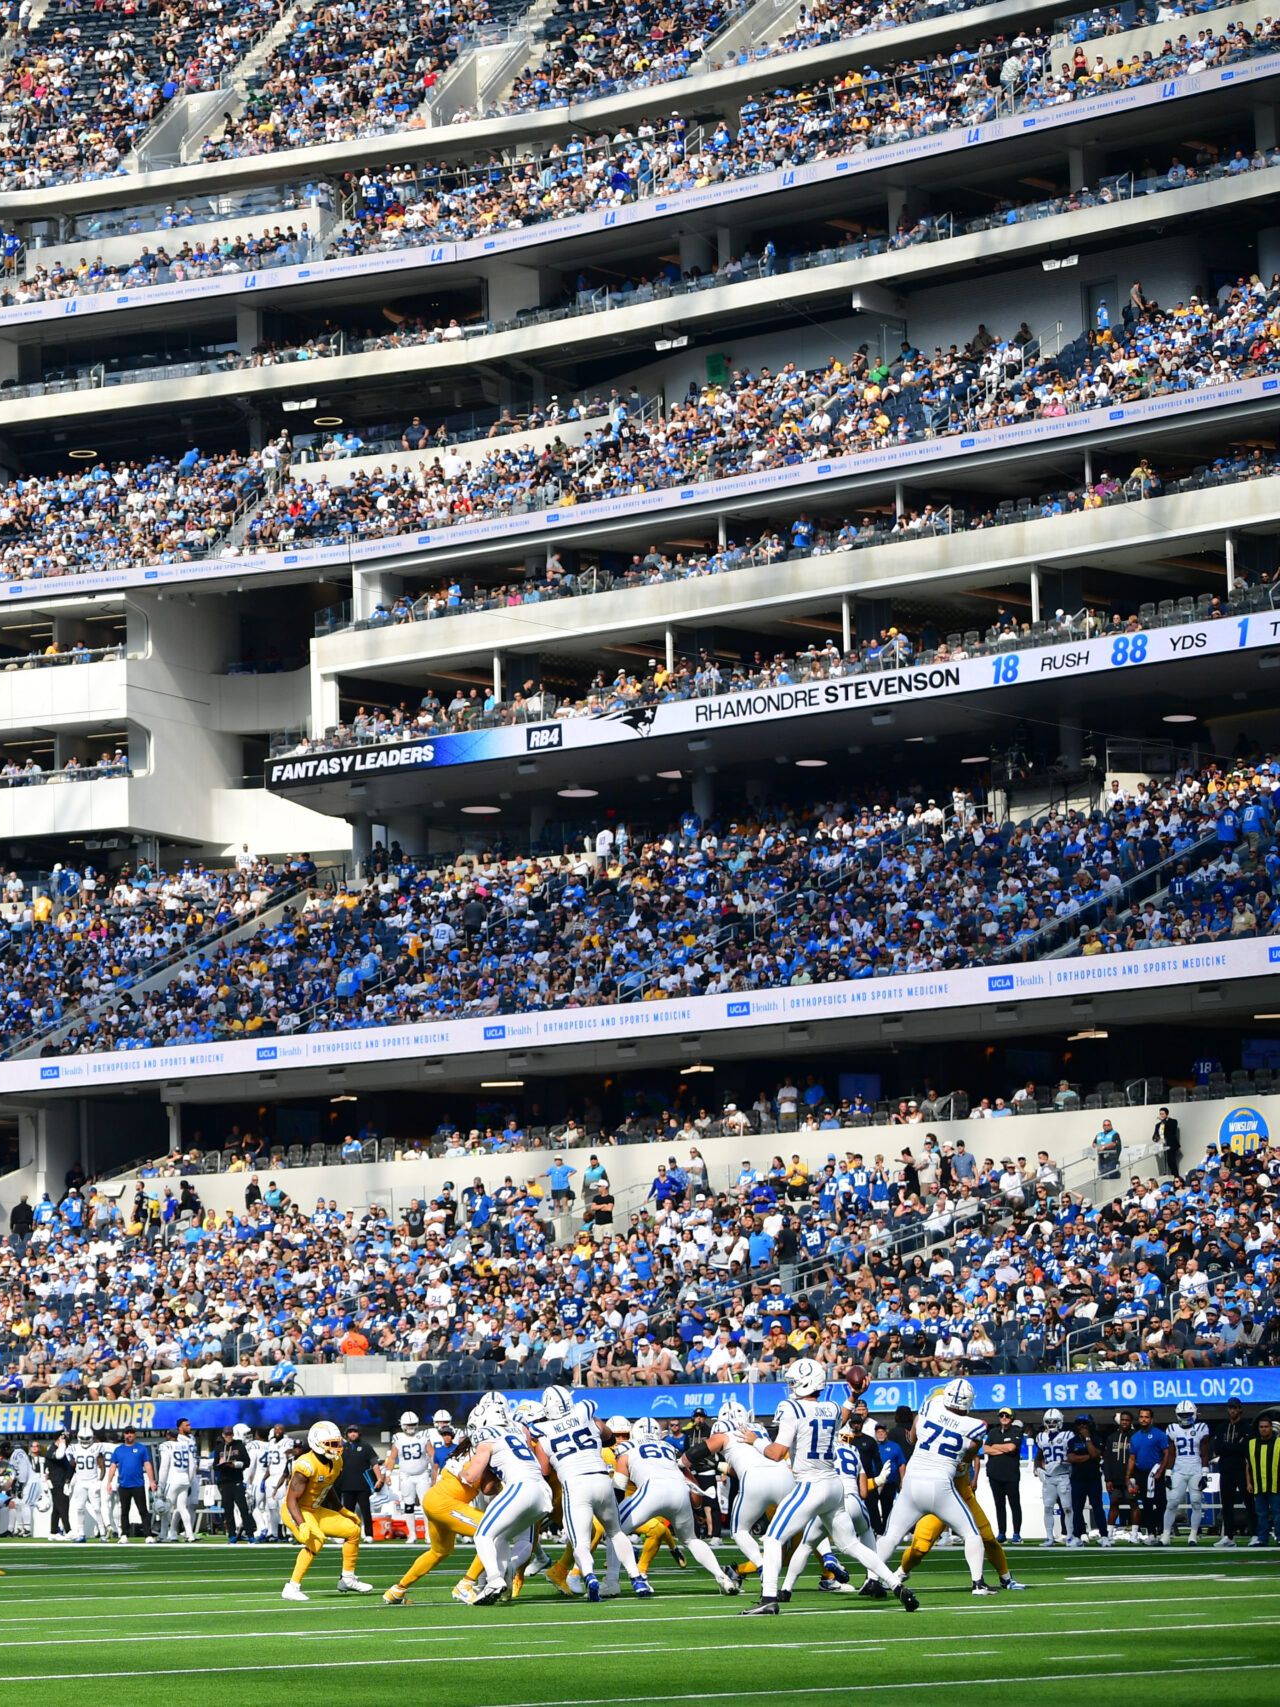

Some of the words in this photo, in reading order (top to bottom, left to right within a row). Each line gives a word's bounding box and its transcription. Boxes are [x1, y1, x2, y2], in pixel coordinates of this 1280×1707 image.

[694, 687, 820, 723] RHAMONDRE
[824, 667, 960, 704] STEVENSON
[992, 654, 1020, 685] 18
[1040, 650, 1090, 672] RUSH
[1110, 634, 1148, 666] 88
[1169, 632, 1207, 652] YDS
[1237, 617, 1250, 648] 1
[530, 728, 560, 750] RB4
[271, 756, 353, 782] FANTASY
[354, 745, 434, 771] LEADERS
[1224, 814, 1234, 826] 12
[1175, 882, 1184, 895] 11
[434, 929, 446, 940] 12
[989, 977, 1012, 989] UCLA
[1014, 975, 1044, 986] Health
[1057, 967, 1117, 982] ORTHOPEDICS
[1122, 964, 1138, 975] AND
[1144, 960, 1177, 973] SPORTS
[1183, 955, 1226, 969] MEDICINE
[728, 1004, 749, 1015] UCLA
[751, 1001, 778, 1012] Health
[791, 994, 847, 1008] ORTHOPEDICS
[852, 992, 866, 1001] AND
[871, 989, 902, 1000] SPORTS
[908, 984, 948, 996] MEDICINE
[485, 1027, 504, 1038] UCLA
[506, 1025, 532, 1036] Health
[544, 1019, 597, 1032] ORTHOPEDICS
[601, 1017, 615, 1026] AND
[620, 1014, 649, 1025] SPORTS
[653, 1010, 690, 1022] MEDICINE
[258, 1048, 276, 1058] UCLA
[278, 1047, 302, 1057] Health
[313, 1041, 361, 1053] ORTHOPEDICS
[366, 1040, 379, 1048] AND
[383, 1037, 412, 1047] SPORTS
[414, 1033, 448, 1044] MEDICINE
[42, 1067, 58, 1078] UCLA
[60, 1066, 83, 1077] Health
[93, 1061, 140, 1072] ORTHOPEDICS
[144, 1060, 156, 1068] AND
[160, 1057, 186, 1067] SPORTS
[190, 1054, 223, 1064] MEDICINE
[1200, 1062, 1212, 1074] 18
[1228, 1120, 1258, 1132] WINSLOW
[1230, 1133, 1259, 1156] 80
[824, 1184, 836, 1196] 17
[808, 1234, 820, 1246] 28
[873, 1386, 901, 1406] 20
[992, 1384, 1006, 1402] 3
[1042, 1382, 1078, 1401] 1ST
[1085, 1380, 1102, 1400] &
[1109, 1379, 1137, 1400] 10
[1153, 1378, 1197, 1398] BALL
[1200, 1378, 1226, 1396] ON
[1230, 1377, 1254, 1396] 20
[684, 1394, 702, 1406] BOLT
[704, 1393, 714, 1406] UP
[32, 1405, 66, 1432] THE
[68, 1402, 155, 1429] THUNDER
[814, 1406, 832, 1418] JONES
[938, 1414, 960, 1428] SMITH
[554, 1417, 580, 1433] NELSON
[472, 1432, 486, 1444] 84
[550, 1427, 598, 1462] 56
[807, 1419, 836, 1460] 17
[920, 1420, 964, 1460] 72
[1176, 1437, 1196, 1456] 21
[402, 1444, 422, 1460] 63
[638, 1444, 676, 1460] 60
[1043, 1446, 1064, 1464] 26
[76, 1454, 94, 1470] 50
